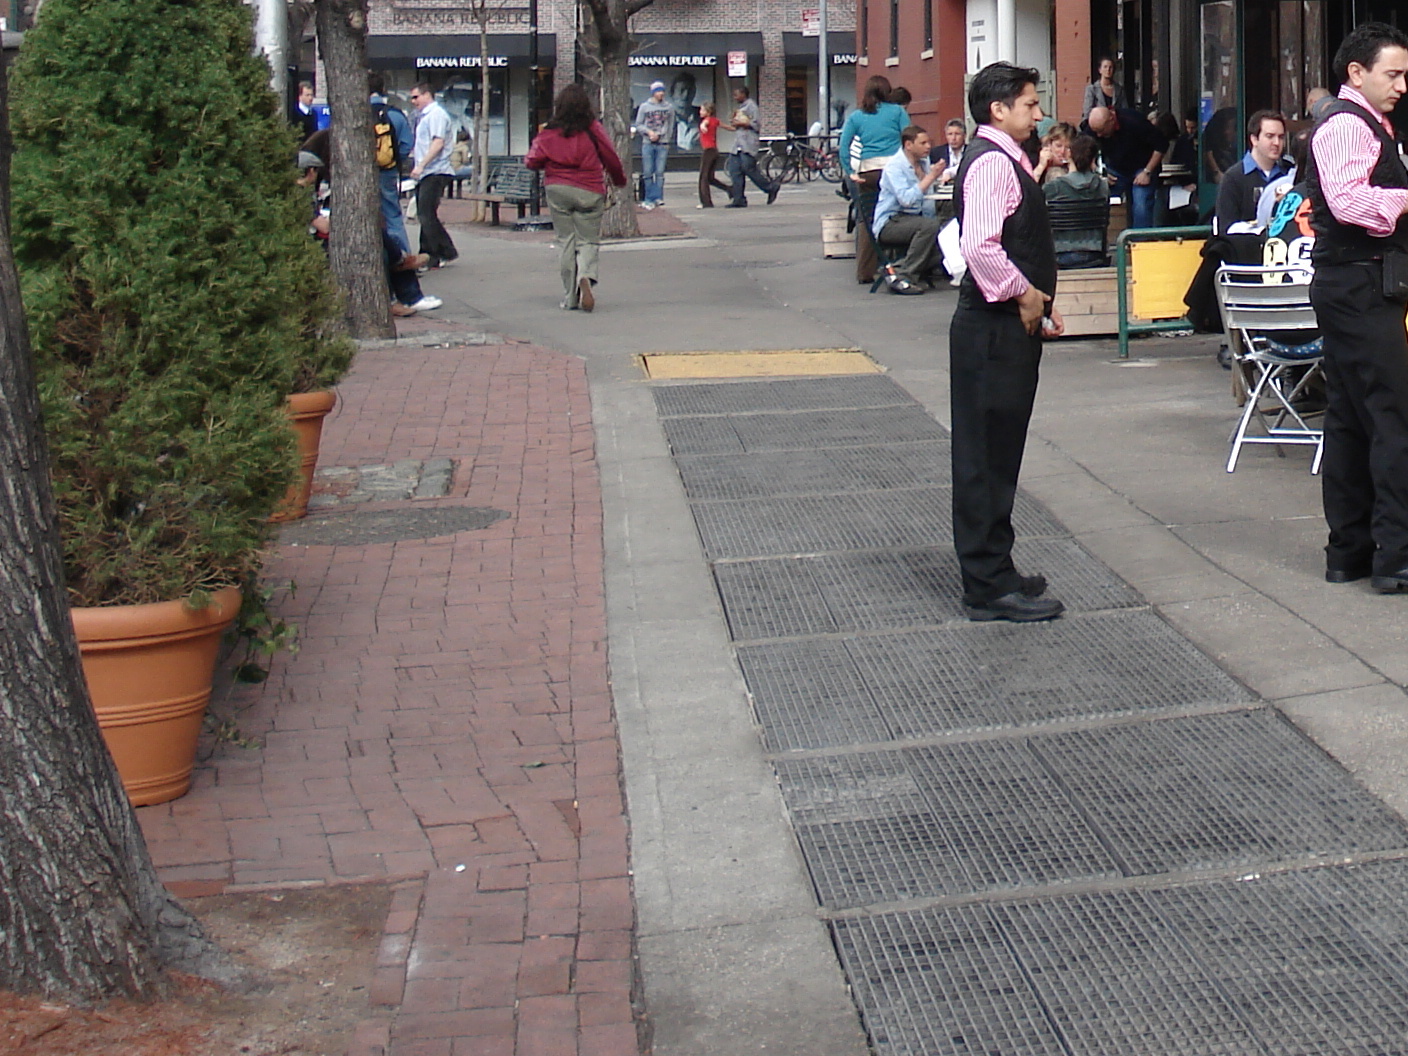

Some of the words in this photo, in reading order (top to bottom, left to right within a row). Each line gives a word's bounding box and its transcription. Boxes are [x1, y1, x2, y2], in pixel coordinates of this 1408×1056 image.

[416, 56, 458, 68] BANANA
[628, 55, 668, 66] BANANA
[669, 55, 717, 66] REPUBLIC
